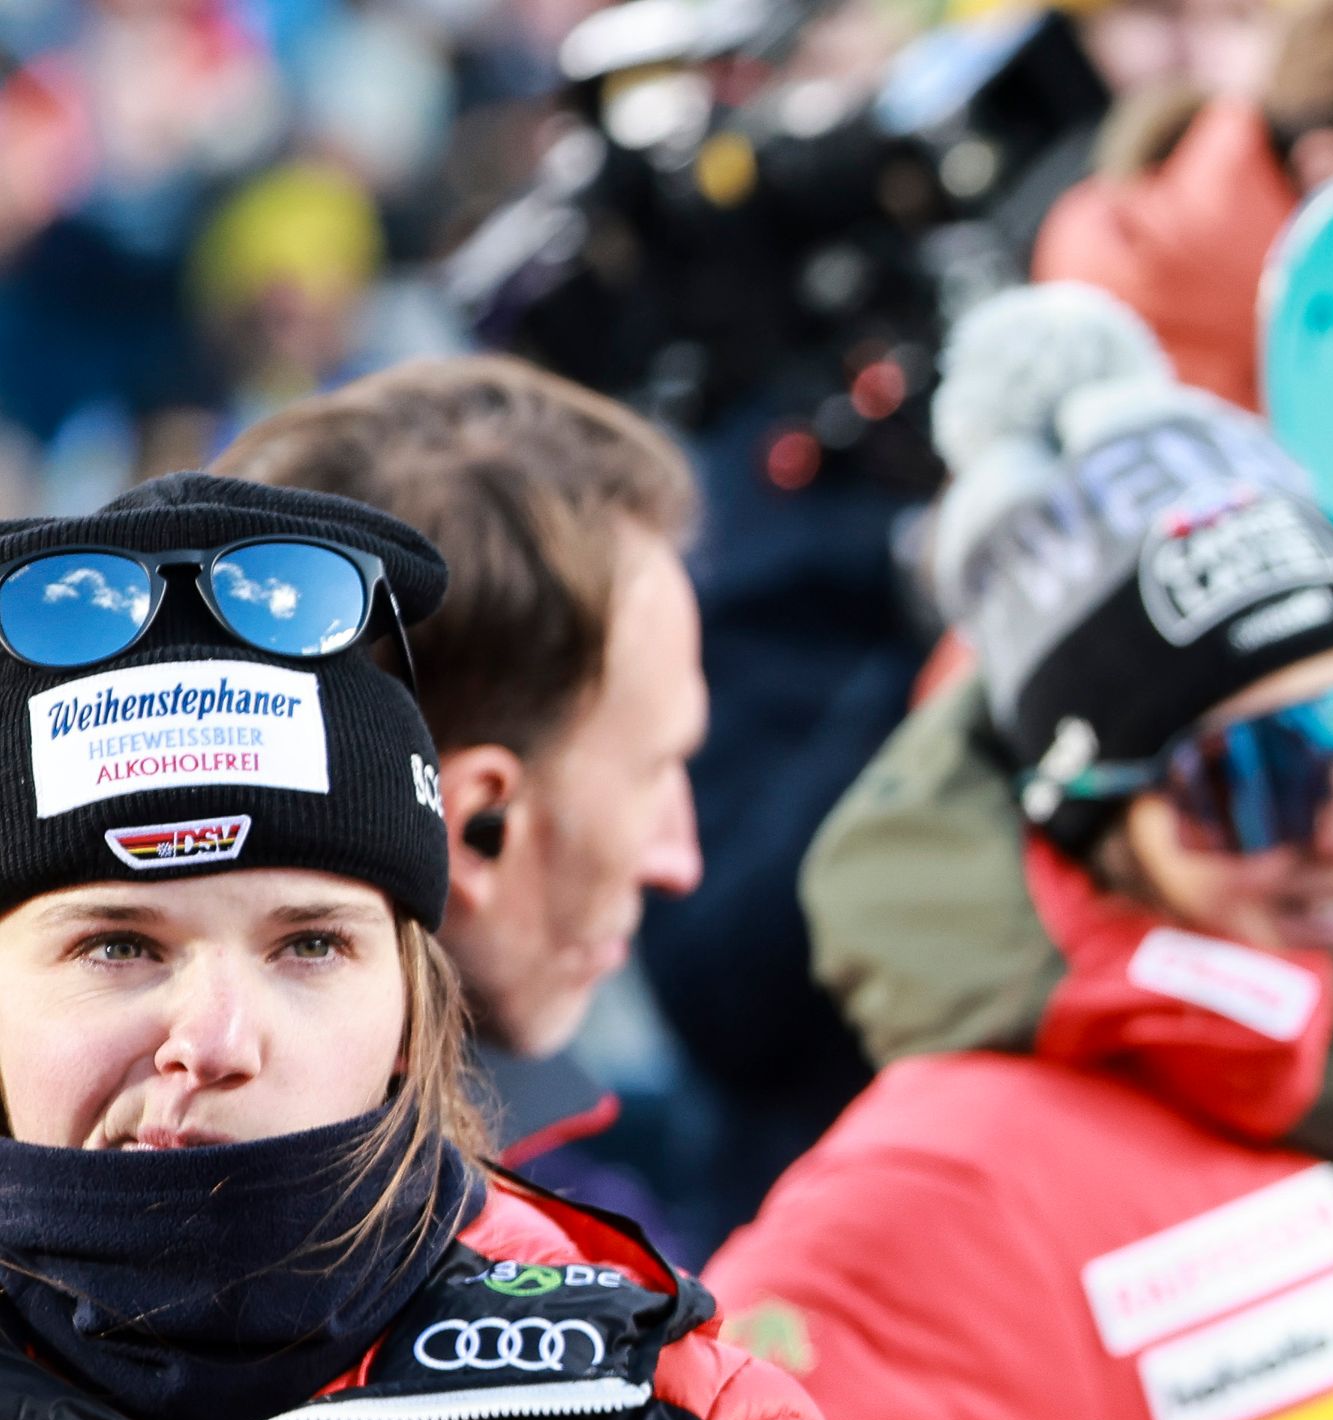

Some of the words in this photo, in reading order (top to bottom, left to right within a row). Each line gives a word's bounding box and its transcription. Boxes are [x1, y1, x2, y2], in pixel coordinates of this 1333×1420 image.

[48, 677, 302, 741] Weihenstephaner
[88, 727, 264, 761] HEFEWEISSBIER
[96, 753, 260, 785] ALKOHOLFREI
[183, 825, 241, 858] DSV
